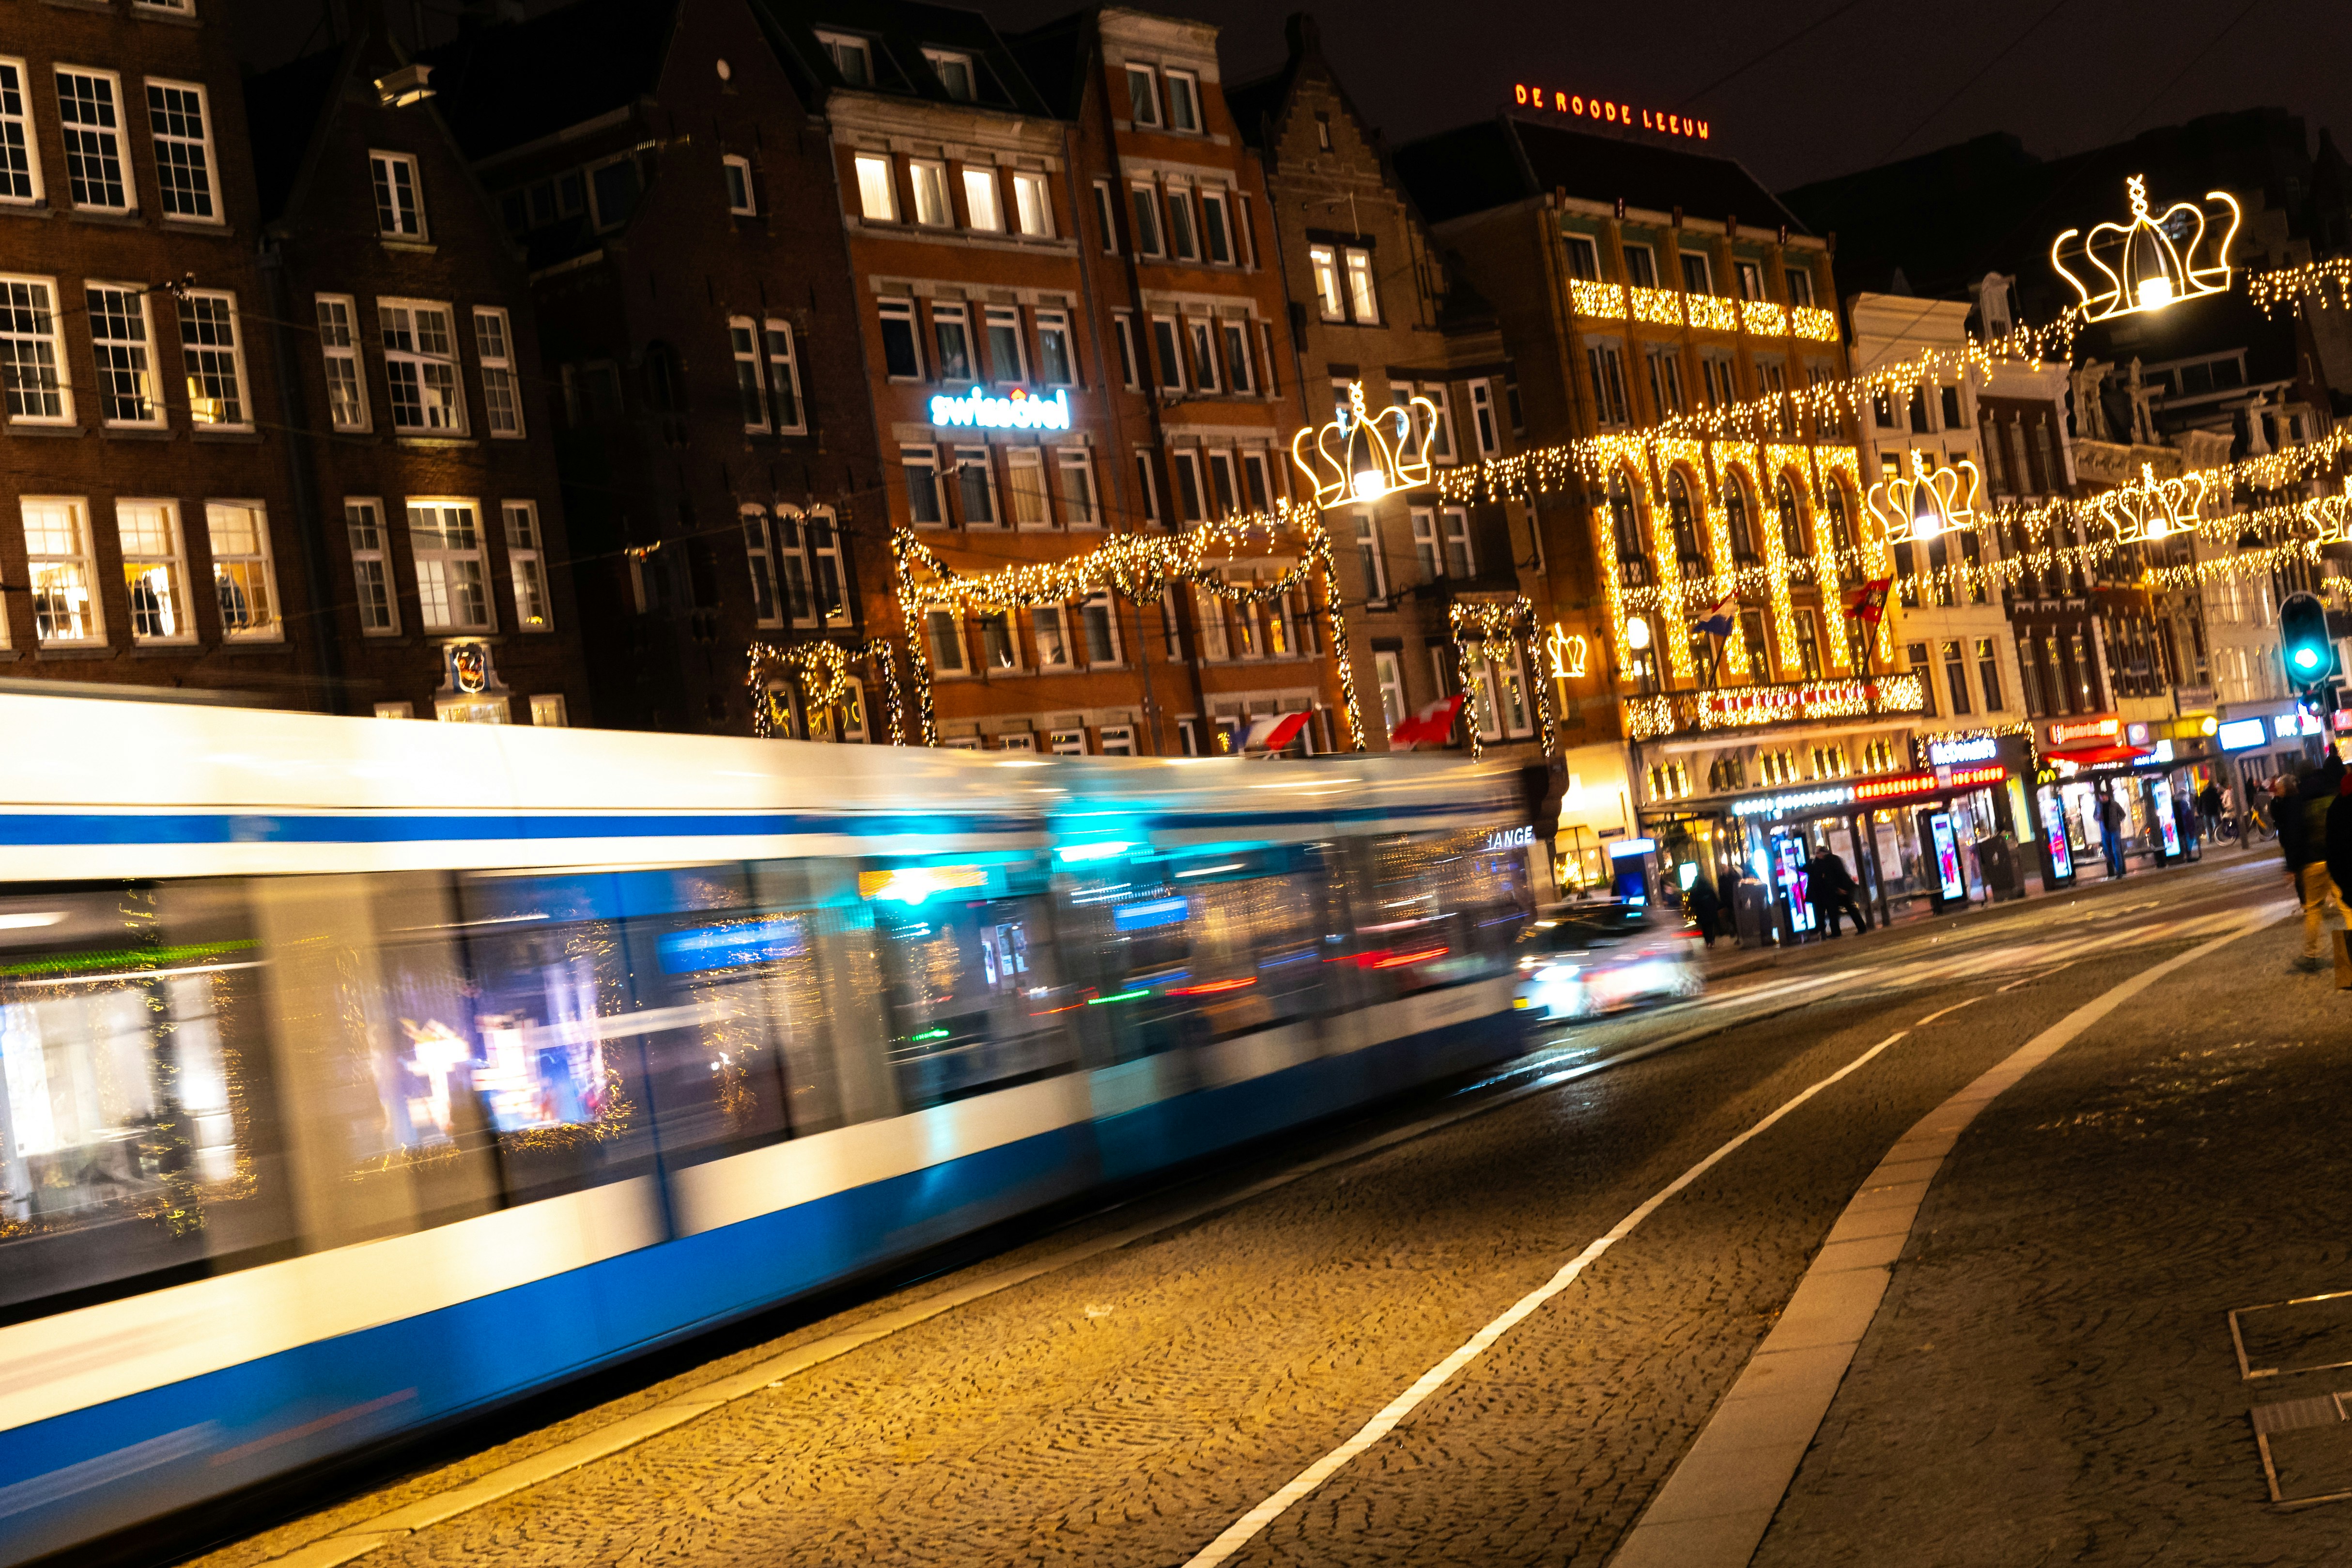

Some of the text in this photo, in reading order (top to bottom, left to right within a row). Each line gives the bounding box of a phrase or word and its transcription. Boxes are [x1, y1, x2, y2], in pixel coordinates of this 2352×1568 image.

[1515, 84, 1708, 140] DE ROODE LEEUW
